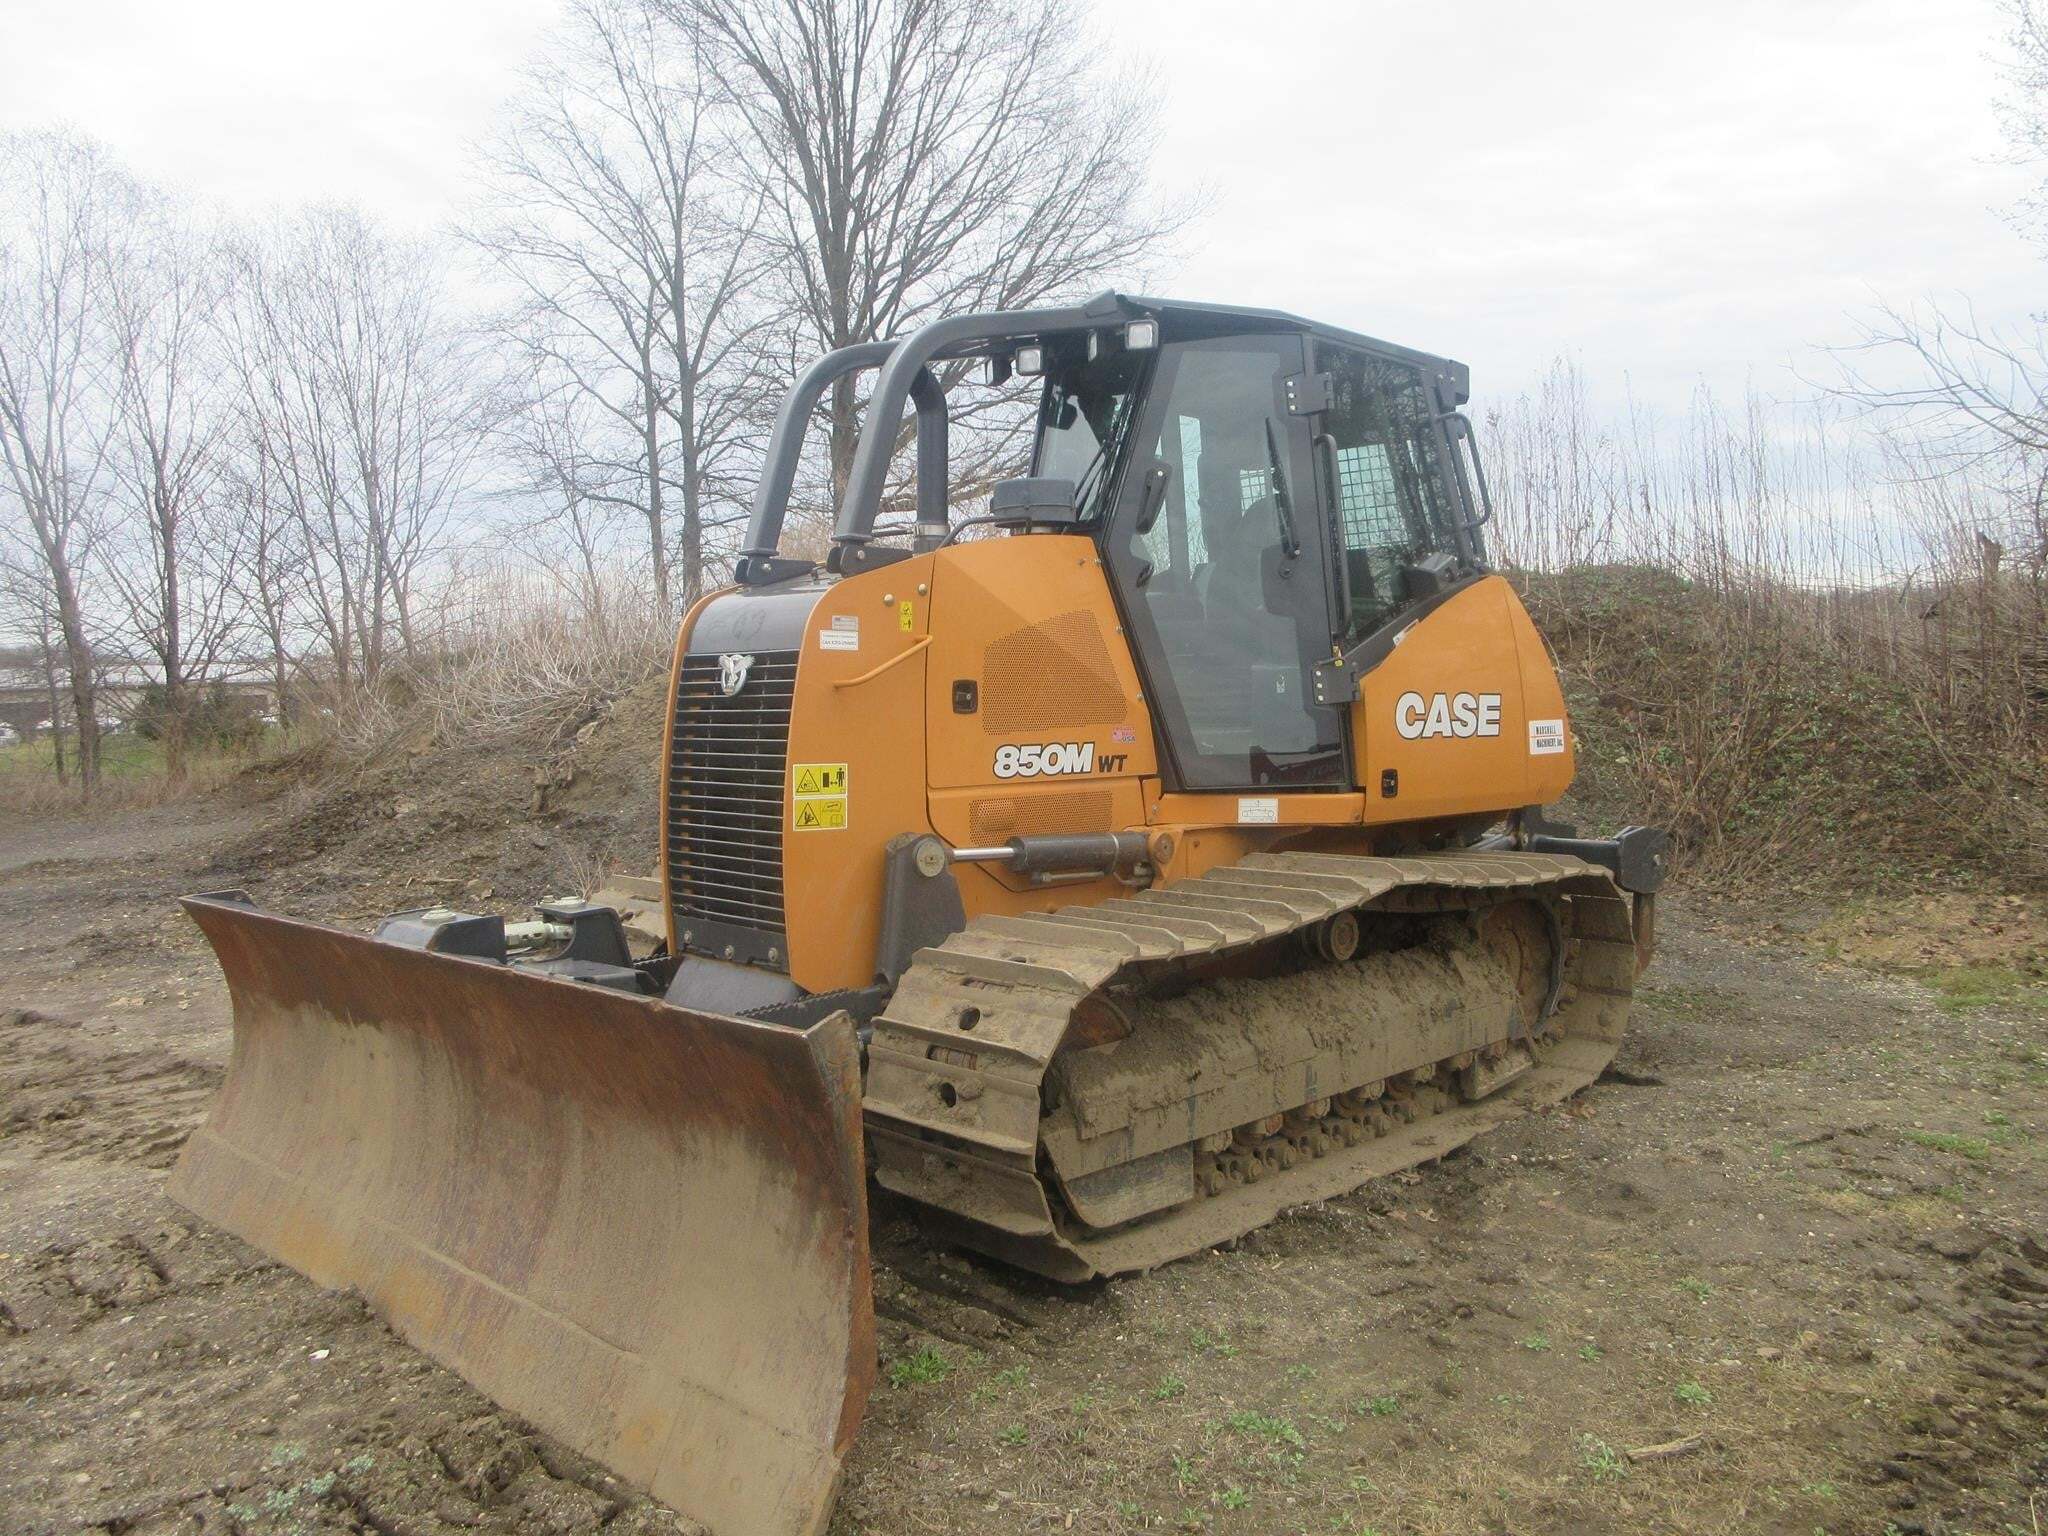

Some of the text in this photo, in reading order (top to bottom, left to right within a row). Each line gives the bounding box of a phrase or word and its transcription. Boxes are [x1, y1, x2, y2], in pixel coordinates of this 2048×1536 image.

[1395, 690, 1501, 740] CASE
[993, 741, 1128, 779] 850M WT
